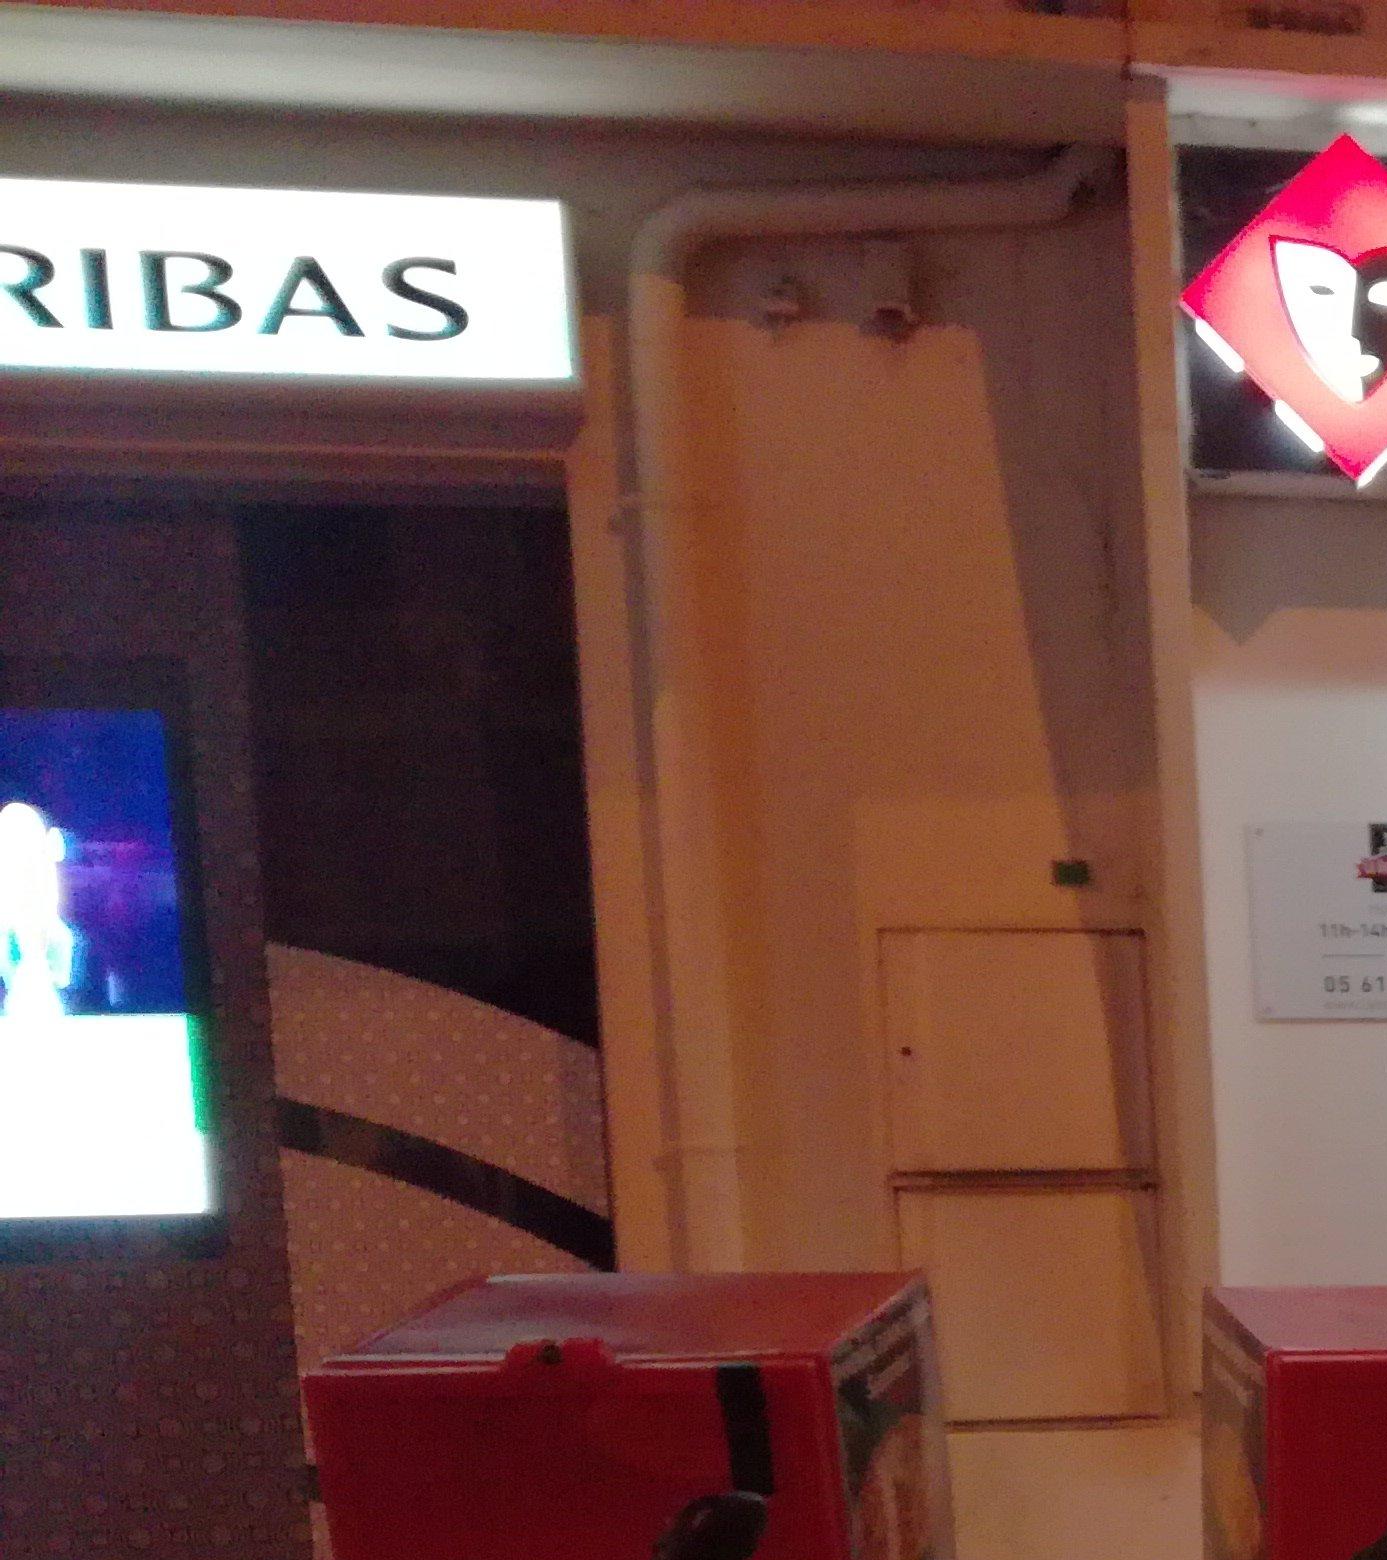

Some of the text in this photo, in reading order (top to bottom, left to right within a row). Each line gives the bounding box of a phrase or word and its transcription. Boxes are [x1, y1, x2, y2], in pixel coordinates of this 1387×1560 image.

[0, 244, 470, 341] RIBAS
[1323, 975, 1351, 993] 05
[1361, 975, 1386, 993] 61
